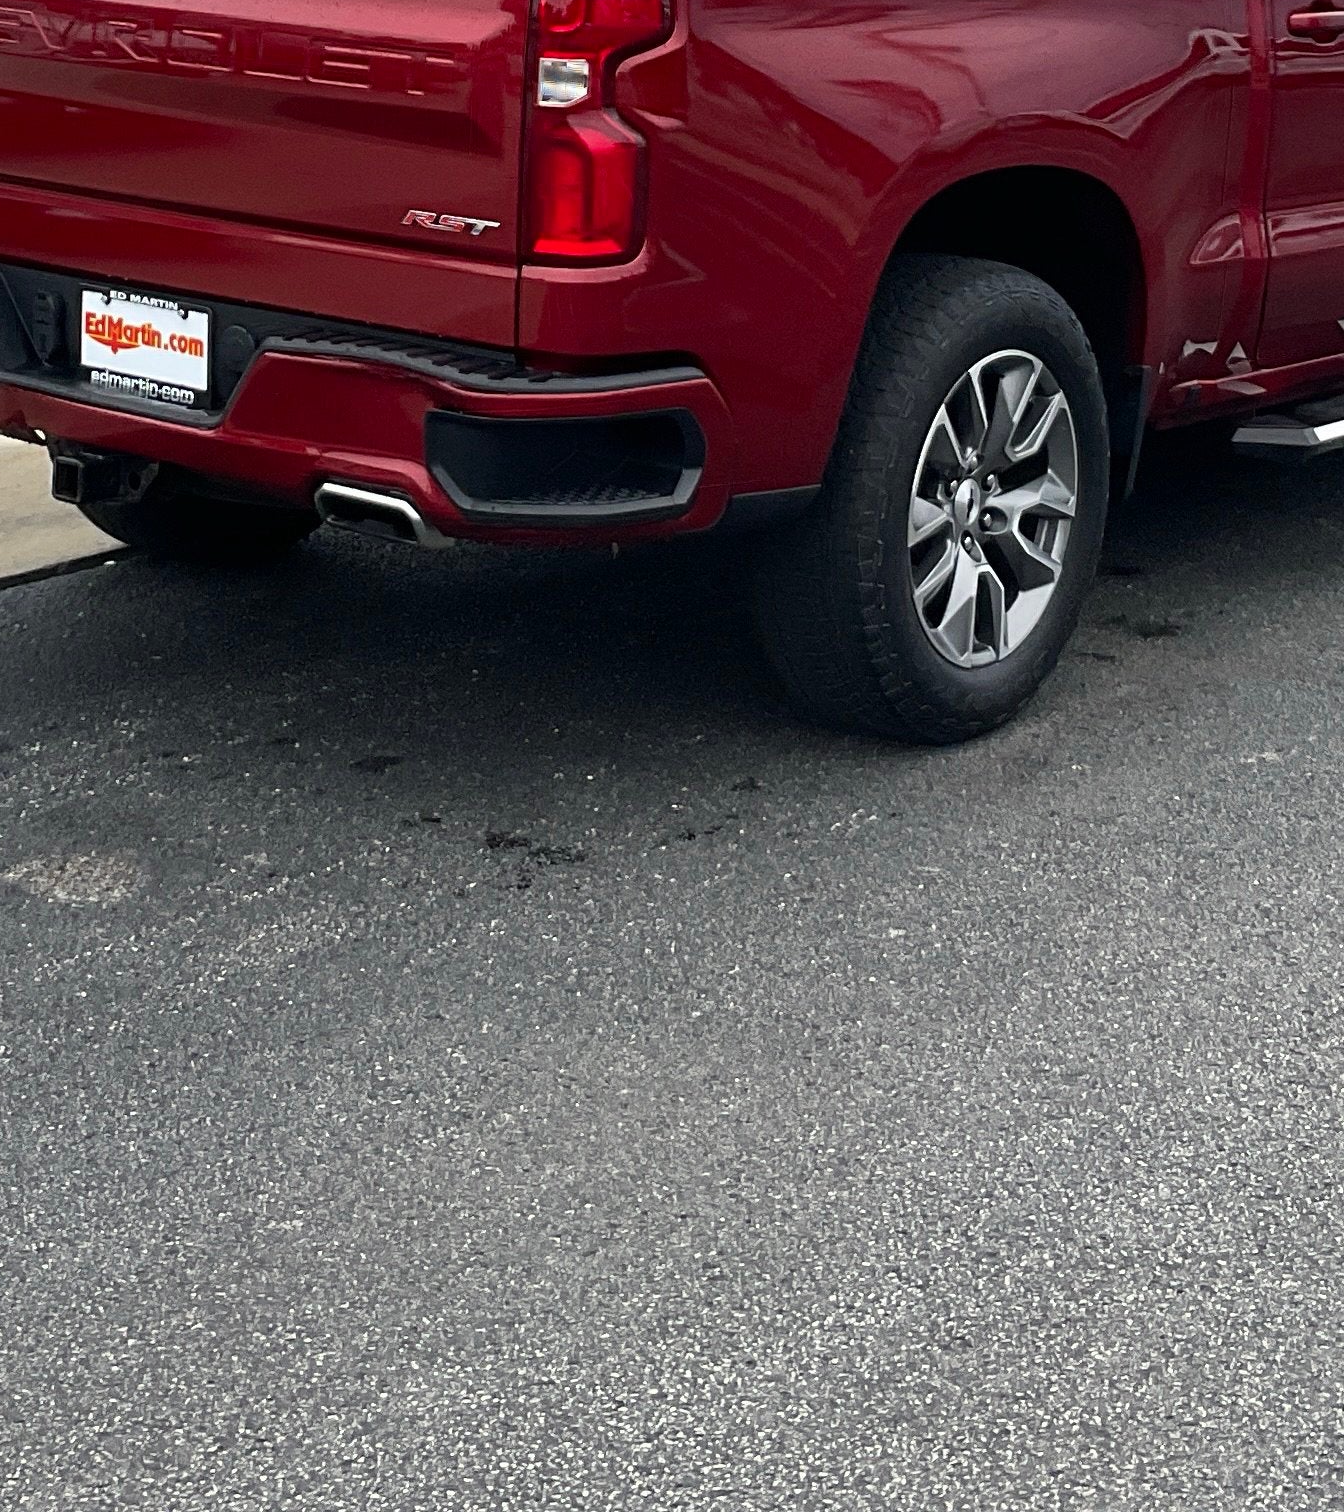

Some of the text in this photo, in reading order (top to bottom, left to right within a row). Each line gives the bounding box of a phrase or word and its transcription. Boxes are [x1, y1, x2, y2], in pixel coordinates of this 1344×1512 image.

[401, 209, 501, 236] RST
[109, 290, 179, 312] ED MARTIN
[90, 368, 195, 401] edmartin.com
